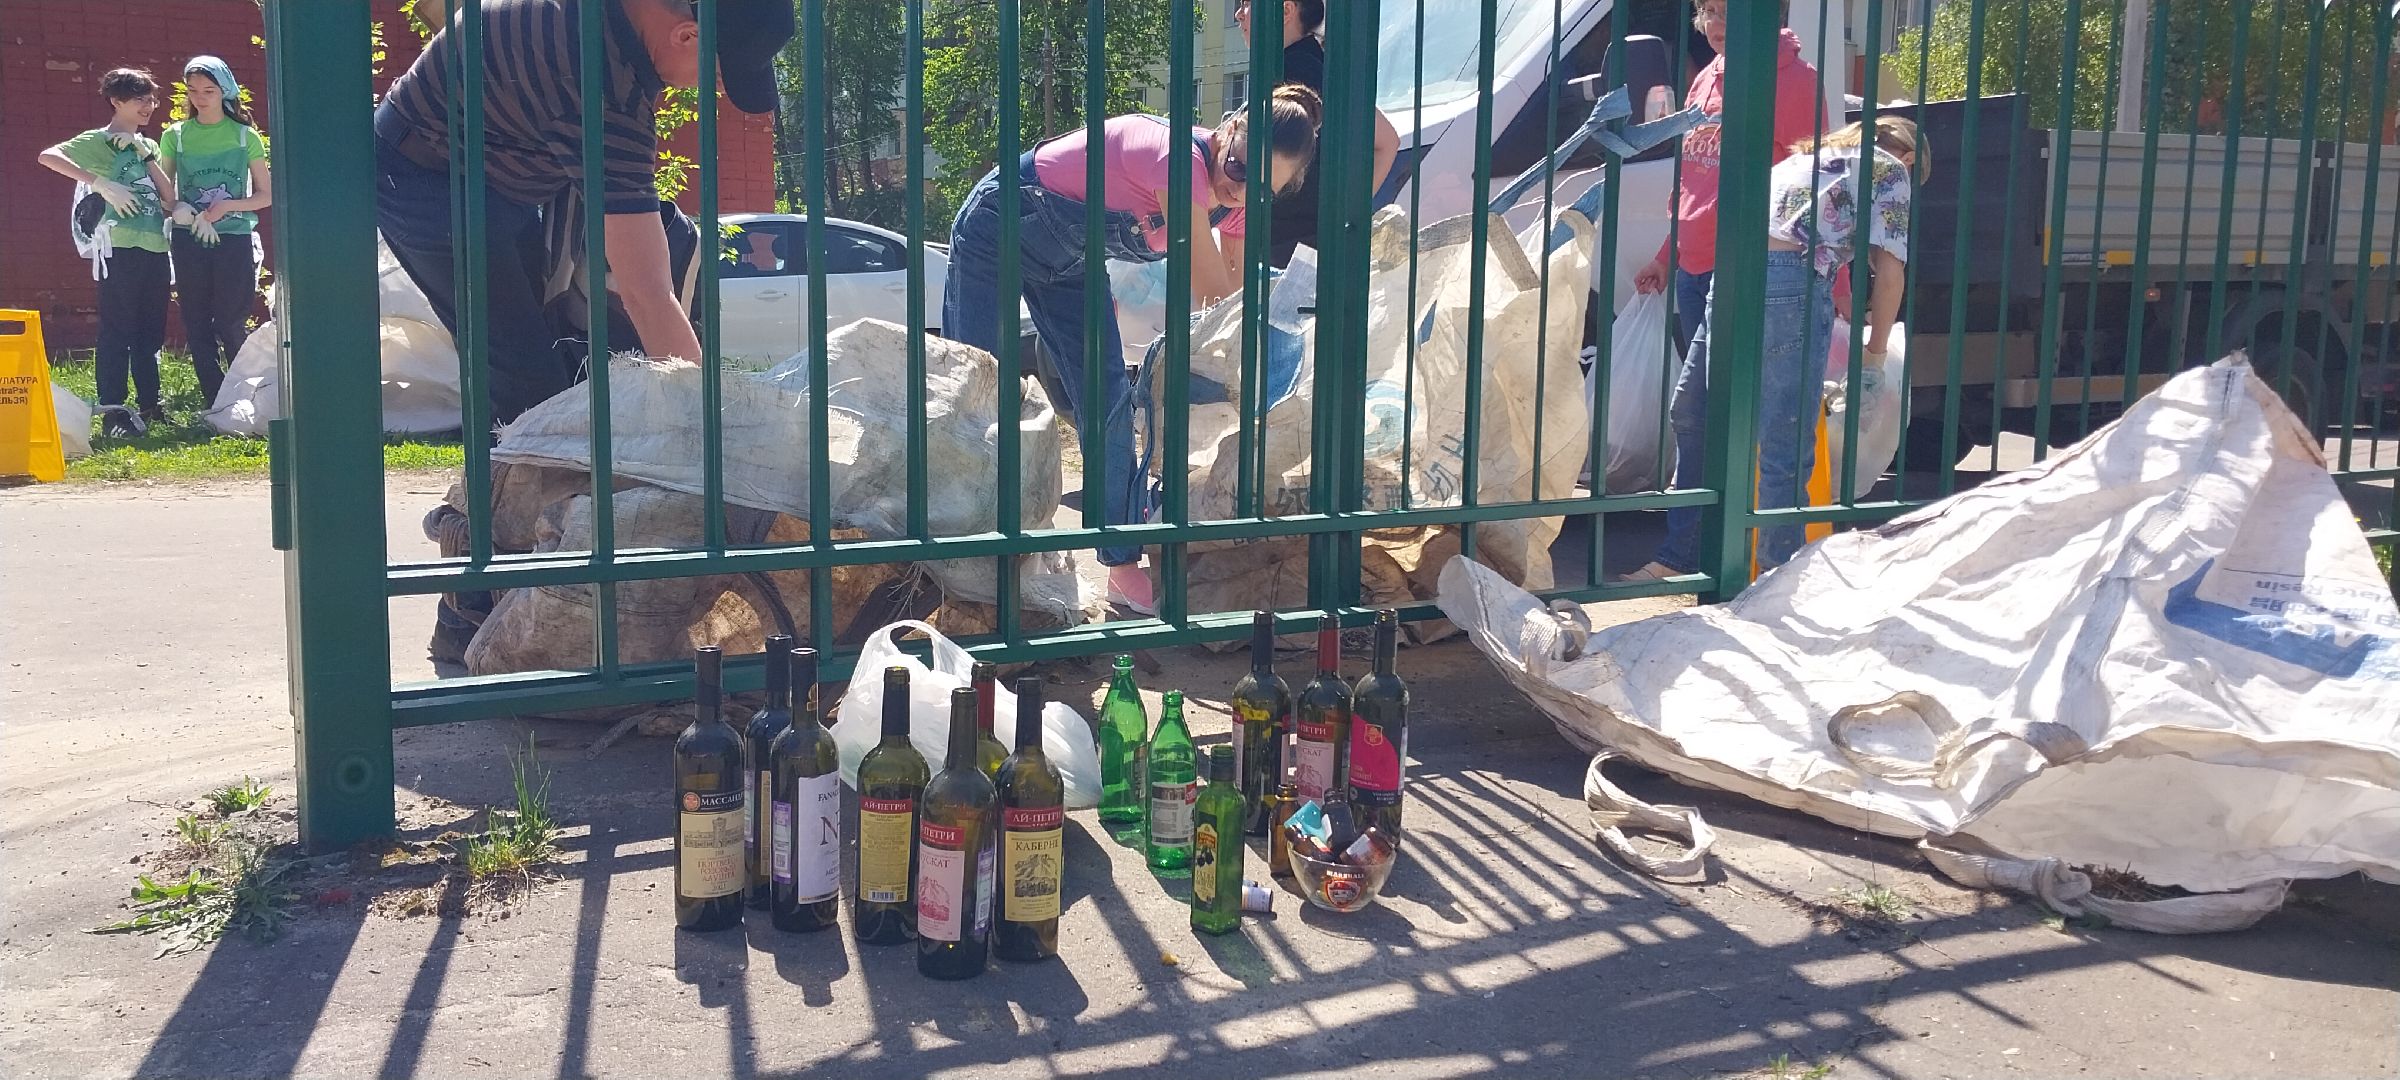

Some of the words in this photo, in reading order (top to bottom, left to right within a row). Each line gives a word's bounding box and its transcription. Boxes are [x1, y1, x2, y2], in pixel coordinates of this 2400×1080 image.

[0, 386, 28, 394] traPak
[2255, 580, 2323, 597] Resin
[701, 791, 744, 806] МАССАНД
[864, 801, 906, 811] АЙ-ПЕТРИ
